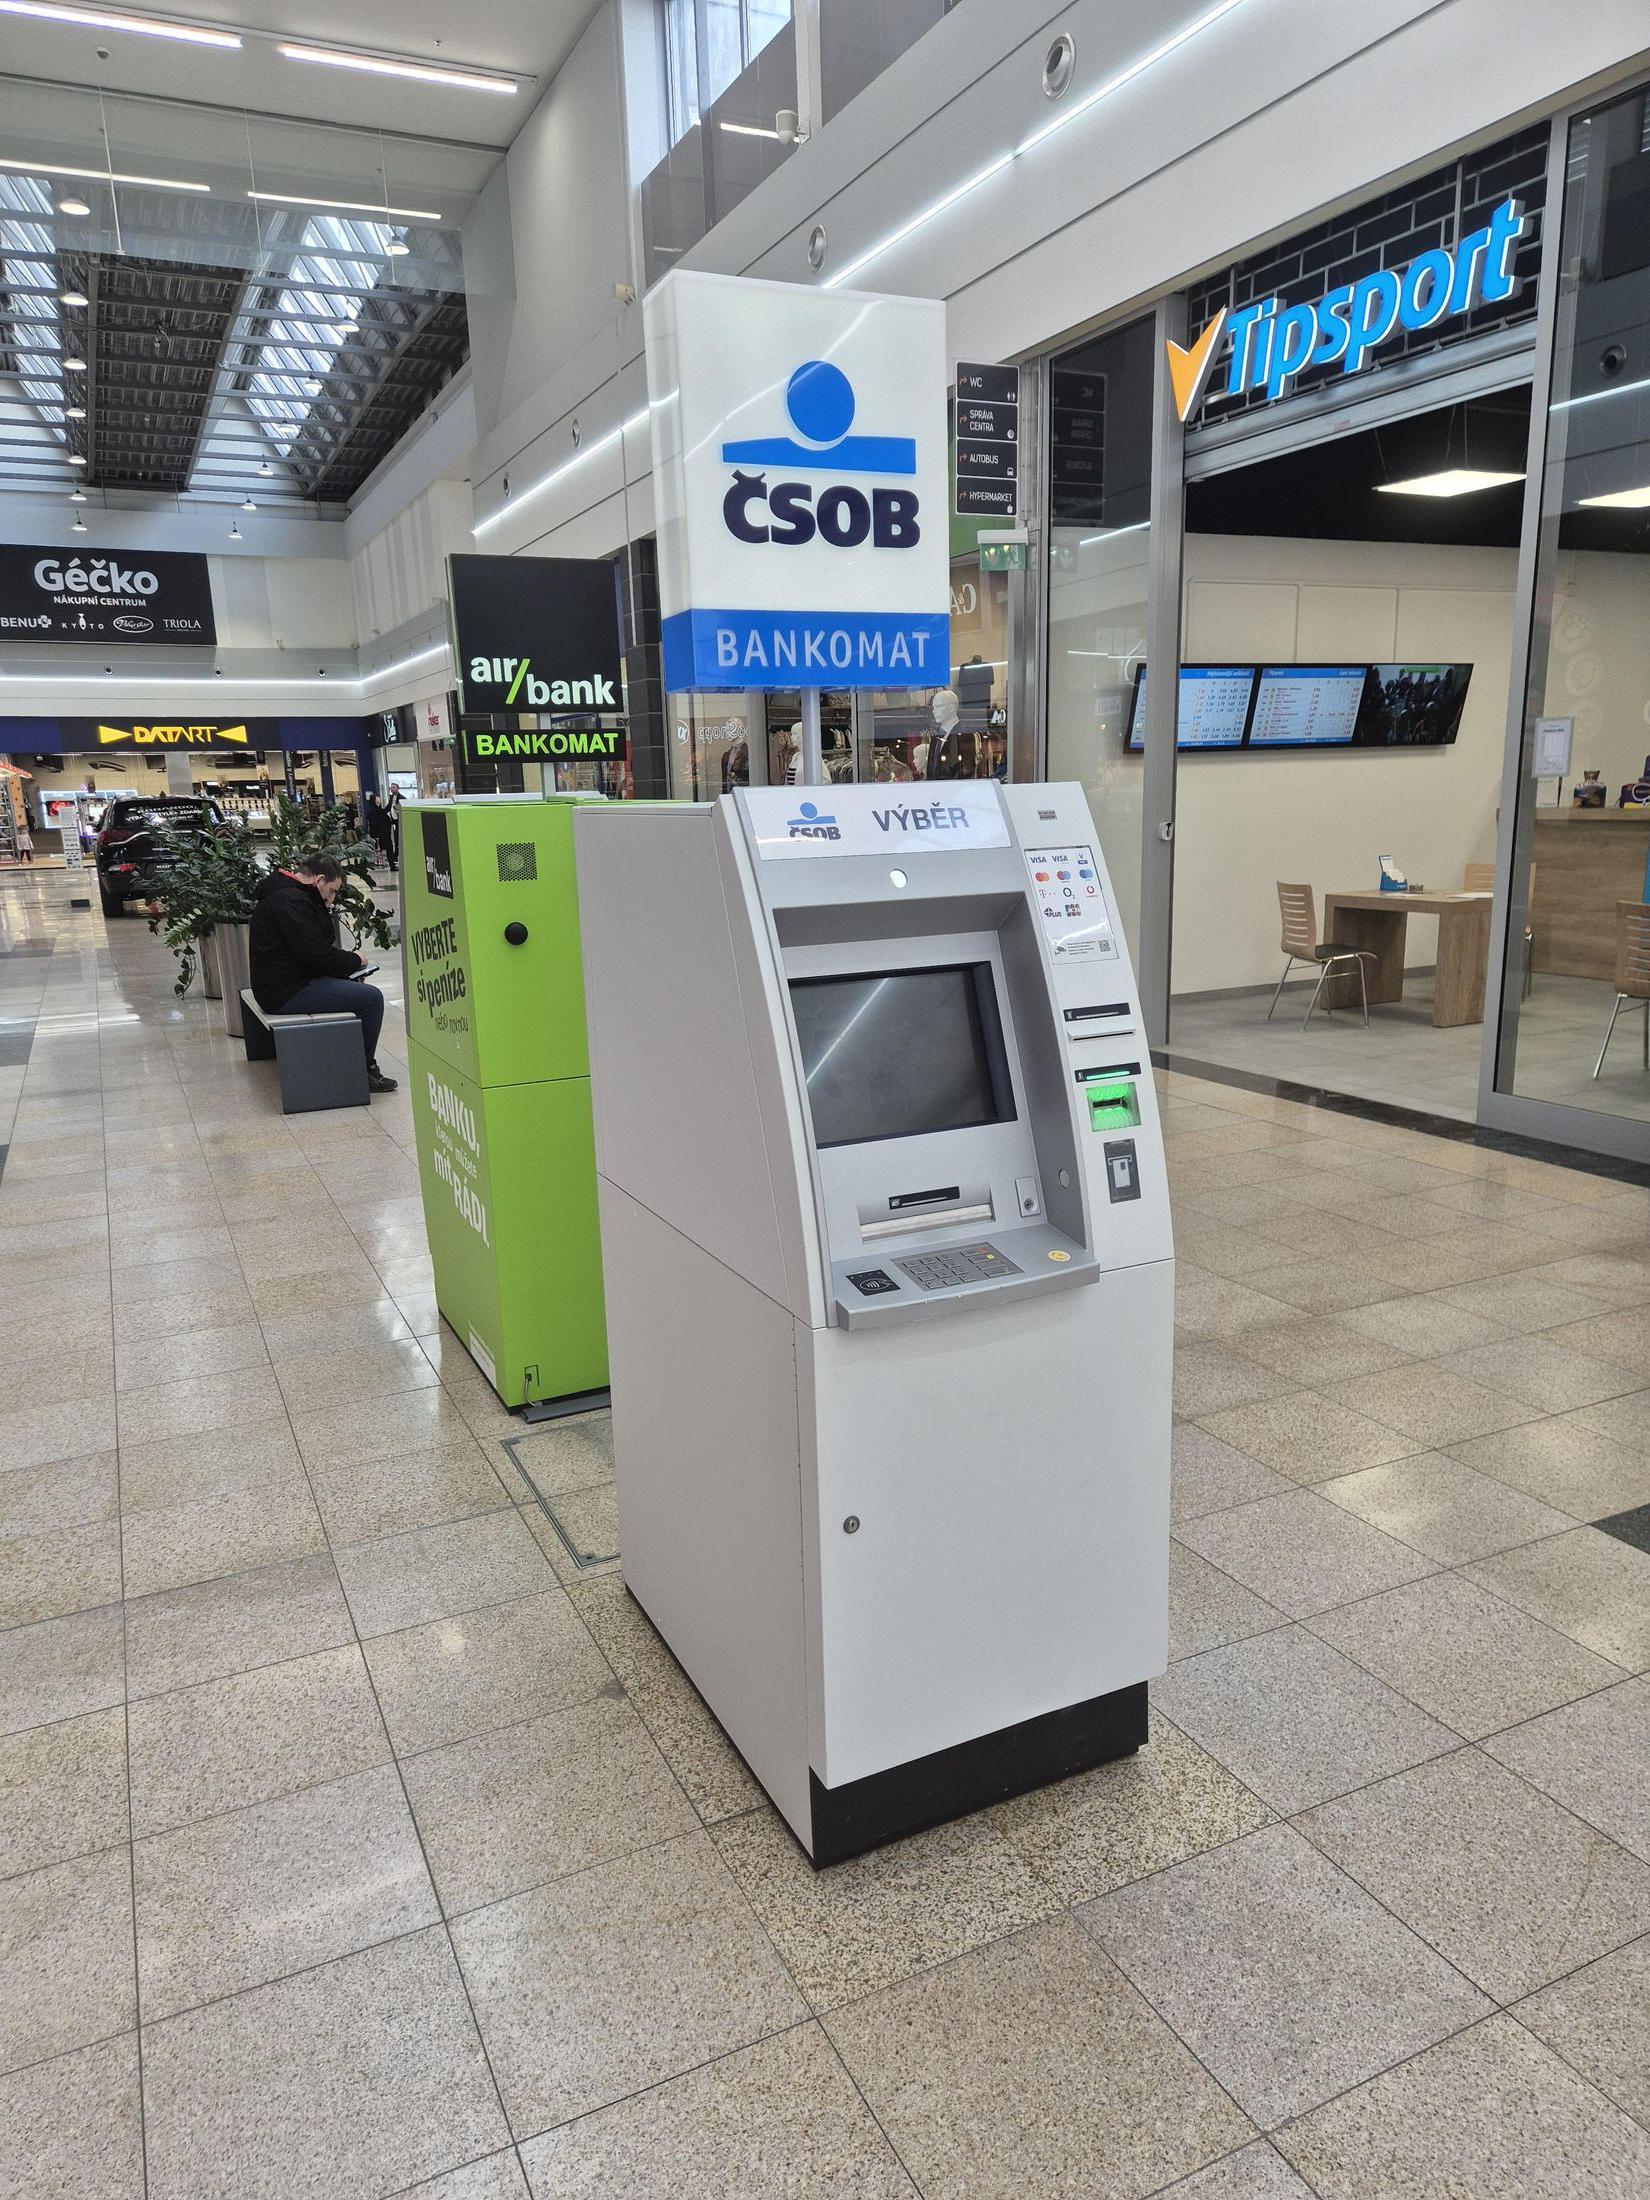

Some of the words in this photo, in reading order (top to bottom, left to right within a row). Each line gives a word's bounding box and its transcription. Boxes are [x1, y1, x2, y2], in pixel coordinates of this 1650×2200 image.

[1226, 198, 1525, 401] Tipsport
[969, 377, 983, 387] WC
[969, 409, 994, 421] SPRÁVA
[969, 421, 994, 433] CENTRA
[969, 453, 999, 464] AUTOBUS
[969, 491, 1013, 502] HYPERMARKET
[722, 469, 921, 548] ČSOB
[34, 557, 159, 595] Géčko
[53, 595, 99, 606] NÁKUPNÍ
[100, 597, 147, 607] CENTRUM
[1, 617, 37, 628] BENU
[163, 619, 201, 629] TRIOLA
[717, 628, 931, 669] BANKOMAT
[134, 726, 218, 743] DATART
[476, 733, 618, 756] BANKOMAT
[789, 826, 841, 841] ČSOB
[871, 802, 969, 832] VÝBĚR
[1030, 856, 1047, 864] VISA
[411, 917, 458, 965] VYBERTE
[417, 970, 427, 1003] si
[426, 960, 466, 1017] peníze
[427, 1072, 480, 1158] BANKU,
[434, 1148, 453, 1186] mít
[452, 1170, 490, 1249] RÁDI.
